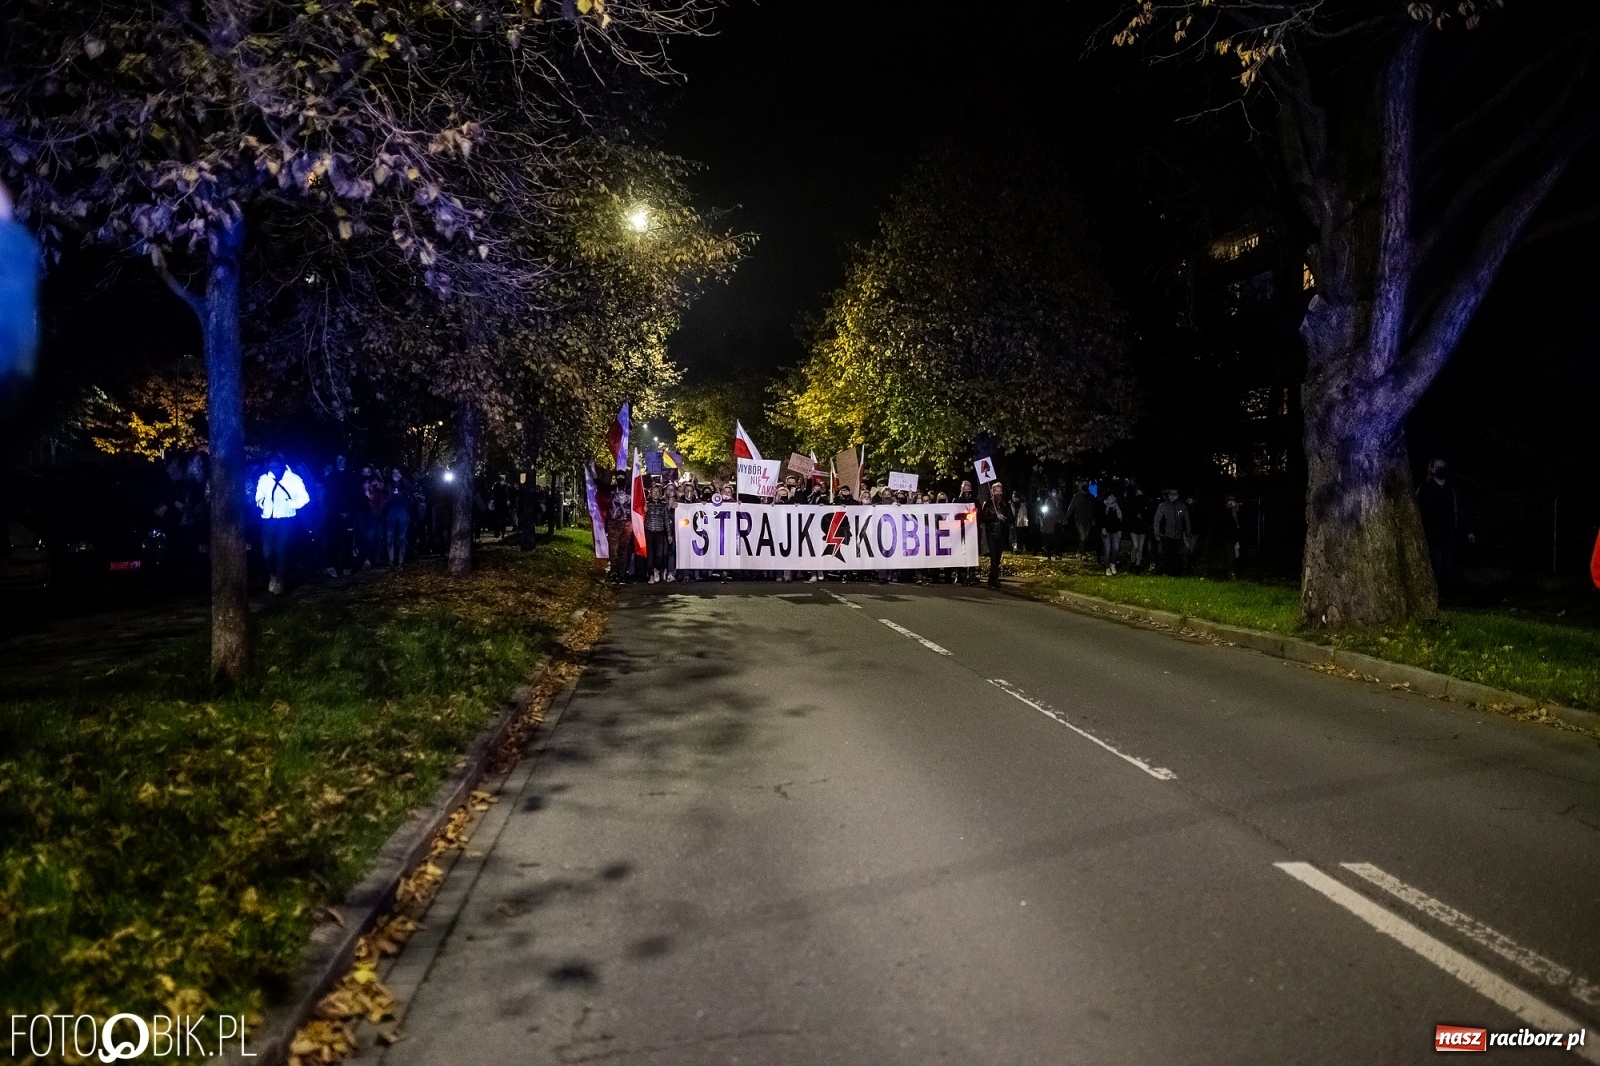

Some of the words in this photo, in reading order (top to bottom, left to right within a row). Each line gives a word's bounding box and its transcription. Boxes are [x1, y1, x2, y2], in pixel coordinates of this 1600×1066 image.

[738, 464, 762, 475] WYBÓR
[750, 476, 761, 485] NIE
[757, 484, 775, 496] ZAKA
[692, 510, 816, 557] STRAJK
[855, 512, 971, 558] KOBIET
